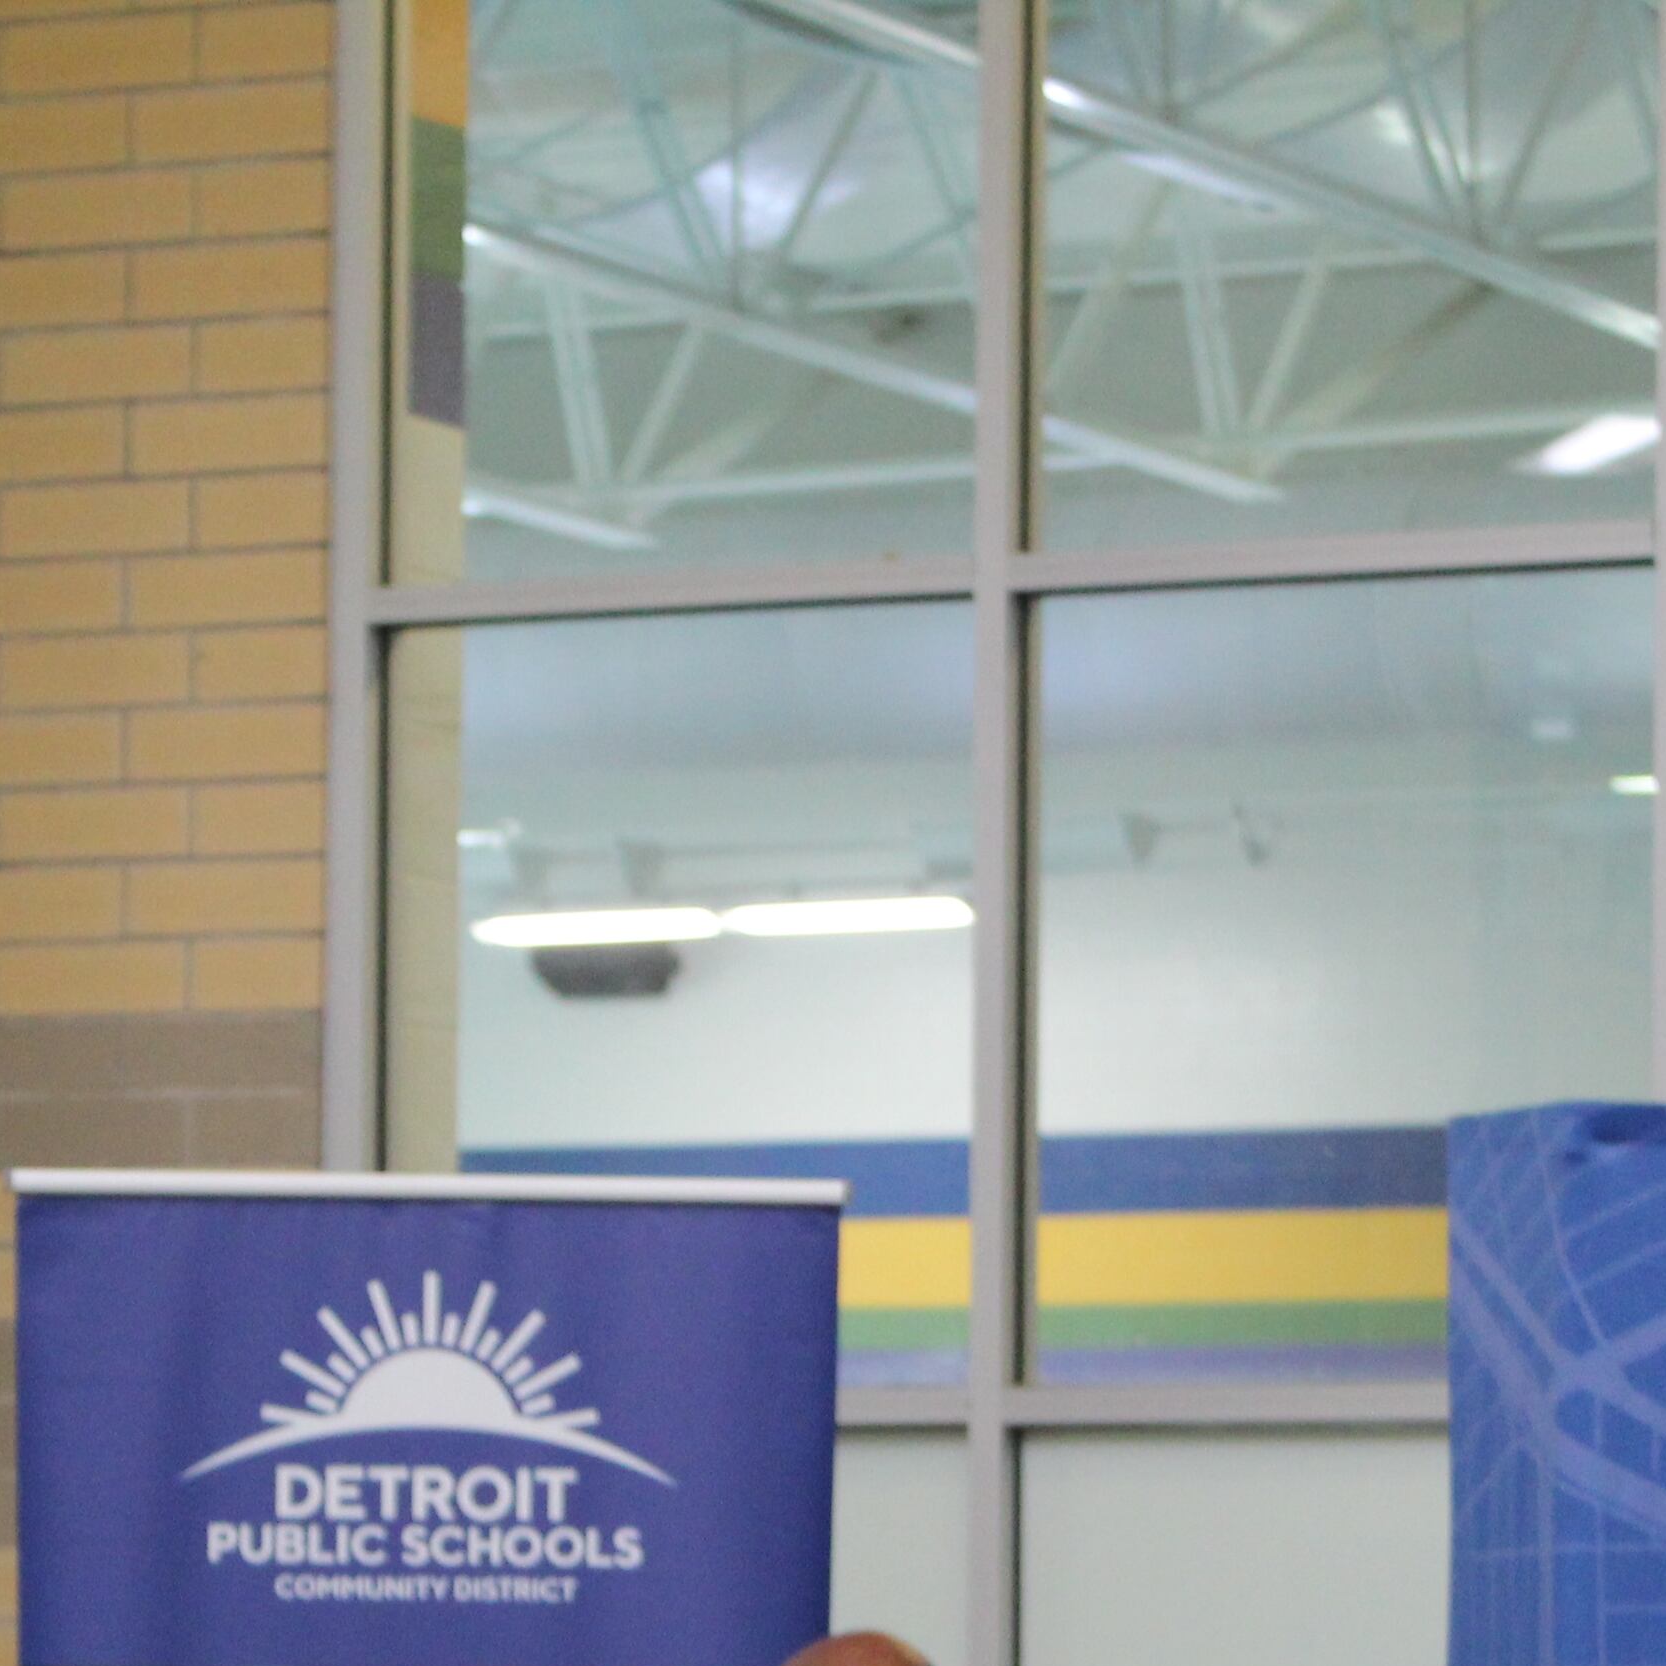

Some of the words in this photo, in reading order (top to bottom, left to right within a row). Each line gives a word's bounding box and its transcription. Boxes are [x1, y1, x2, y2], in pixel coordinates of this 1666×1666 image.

[275, 1464, 579, 1524] DETROIT
[206, 1521, 387, 1567] PUBLIC
[401, 1524, 644, 1571] SCHOOLS
[275, 1572, 449, 1603] COMMUNITY
[454, 1575, 579, 1604] DISTRICT
